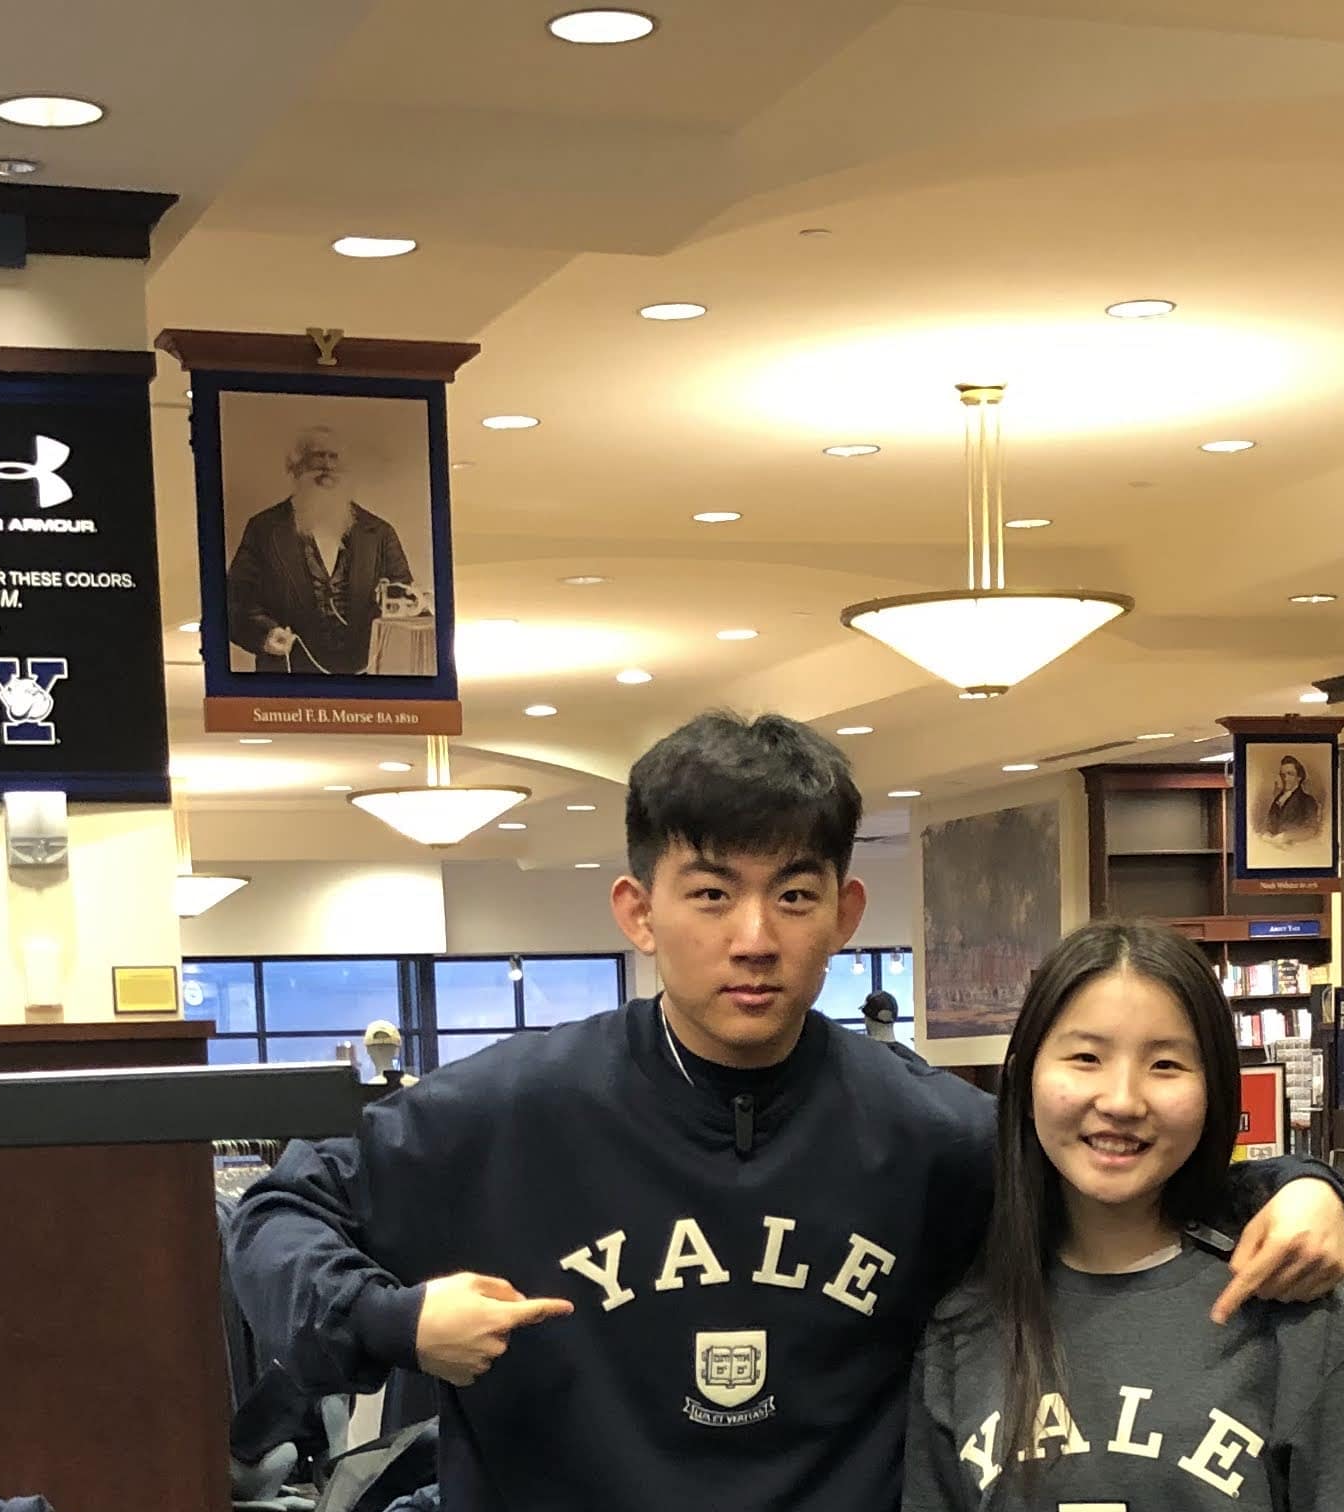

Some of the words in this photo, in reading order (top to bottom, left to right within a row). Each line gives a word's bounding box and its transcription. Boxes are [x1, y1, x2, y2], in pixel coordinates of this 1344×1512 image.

[8, 517, 97, 533] ARMOUR
[9, 571, 62, 587] THESE
[64, 572, 136, 588] COLORS.
[253, 708, 303, 723] Samuel
[332, 710, 374, 724] Morse
[377, 713, 394, 724] BA
[559, 1216, 896, 1316] YALE
[960, 1385, 1264, 1498] YALE
